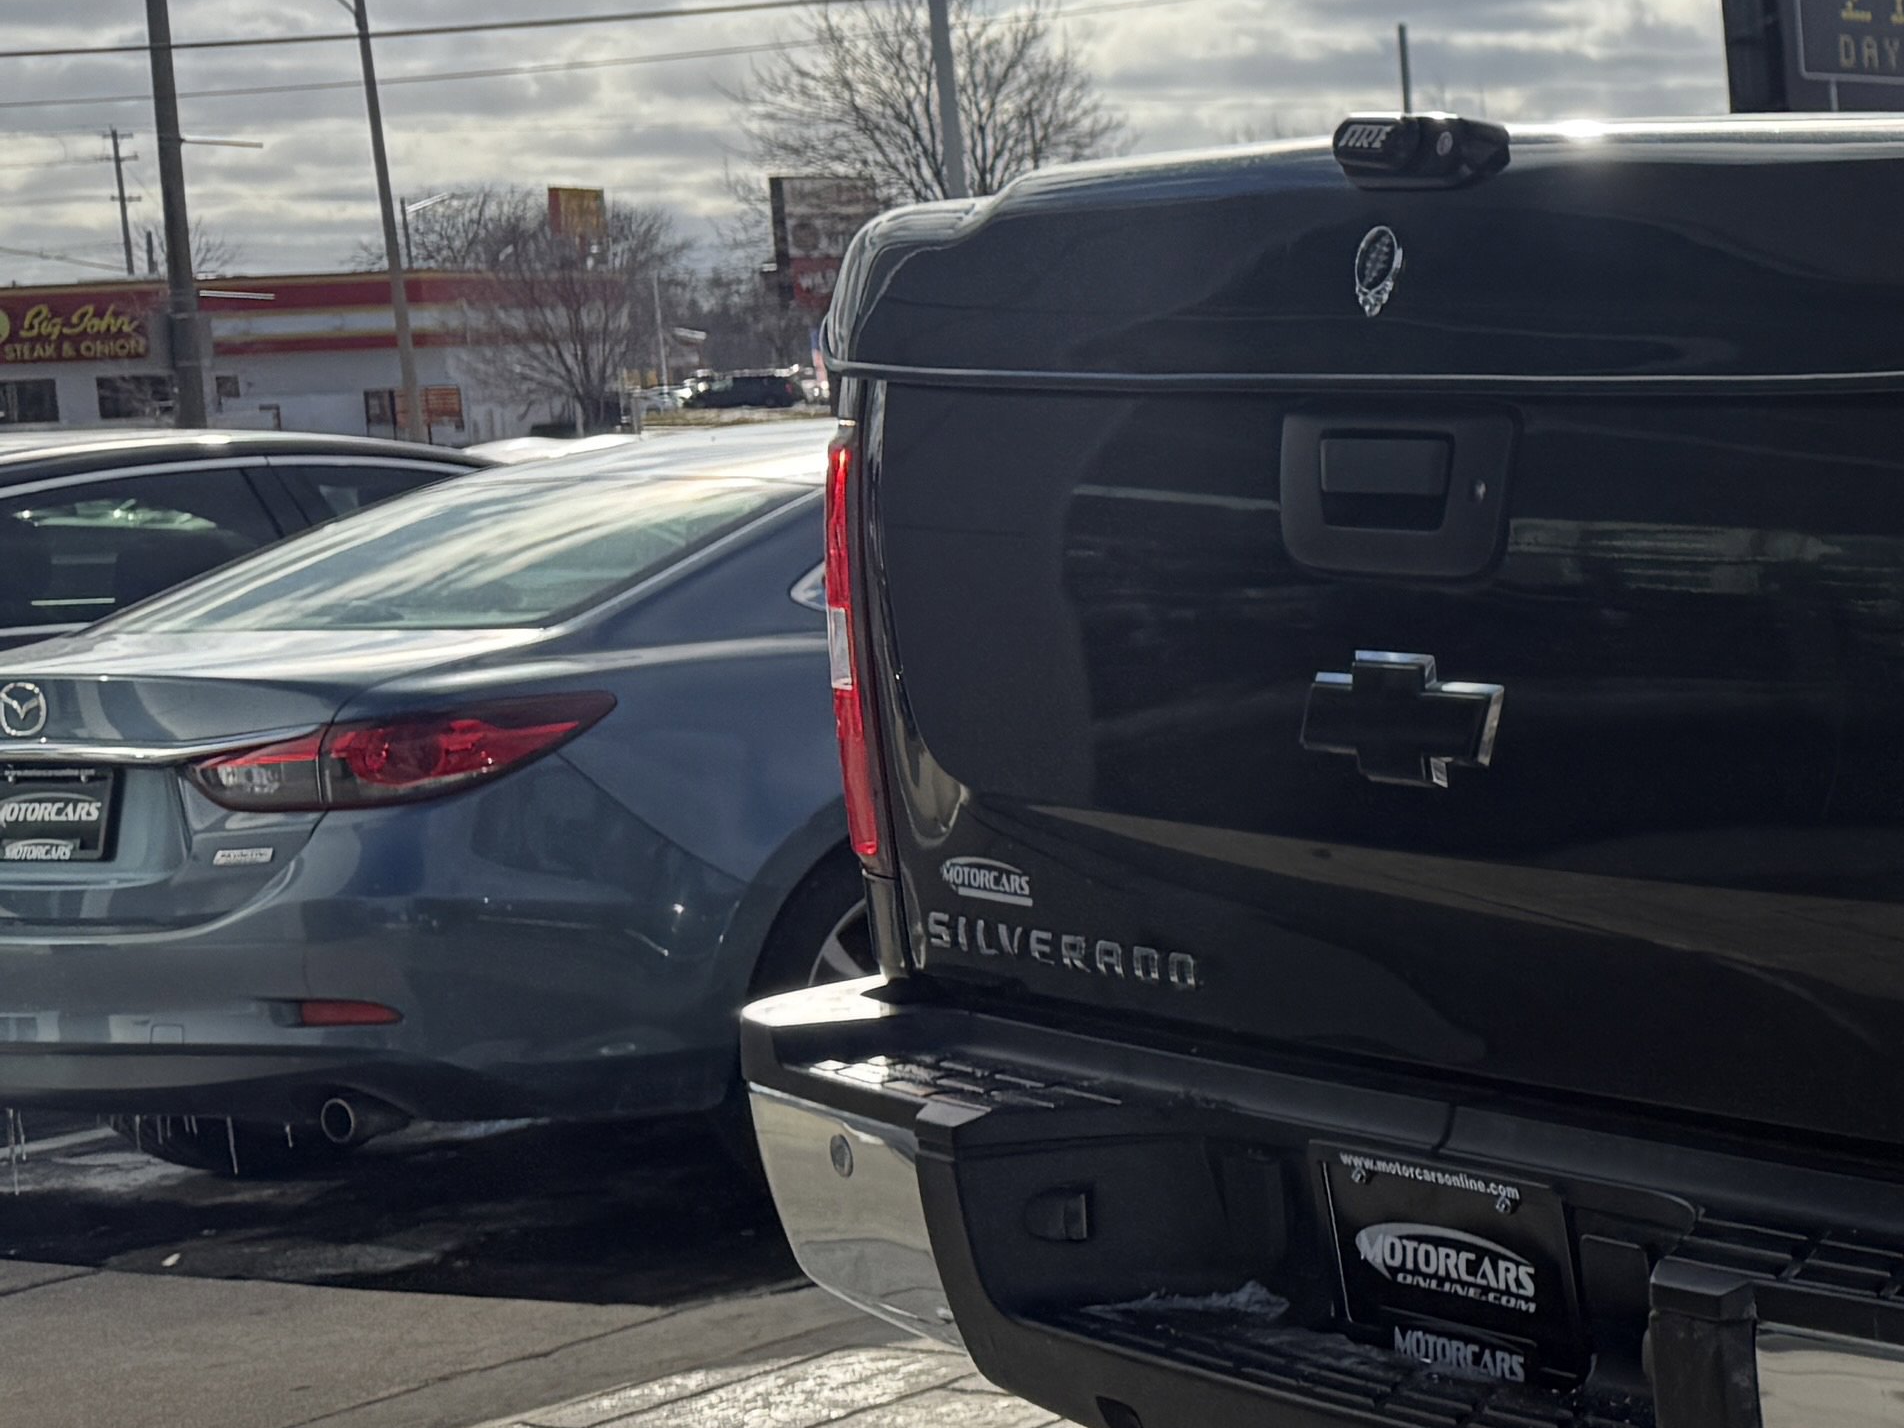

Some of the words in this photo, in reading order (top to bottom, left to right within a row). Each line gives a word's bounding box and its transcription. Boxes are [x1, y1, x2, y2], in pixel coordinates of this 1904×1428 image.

[19, 303, 64, 340] Big
[62, 303, 140, 335] John
[4, 343, 57, 361] STEAK
[62, 341, 76, 359] &
[79, 337, 147, 359] ONION
[941, 863, 1031, 896] MOTORCARS
[927, 911, 1197, 988] SILVERADO
[1339, 1151, 1521, 1200] www.motorcarsonline.com
[1360, 1231, 1536, 1298] MOTORCARS
[1396, 1271, 1538, 1315] ONLINE.COM
[1394, 1325, 1526, 1383] MOTORCARS
